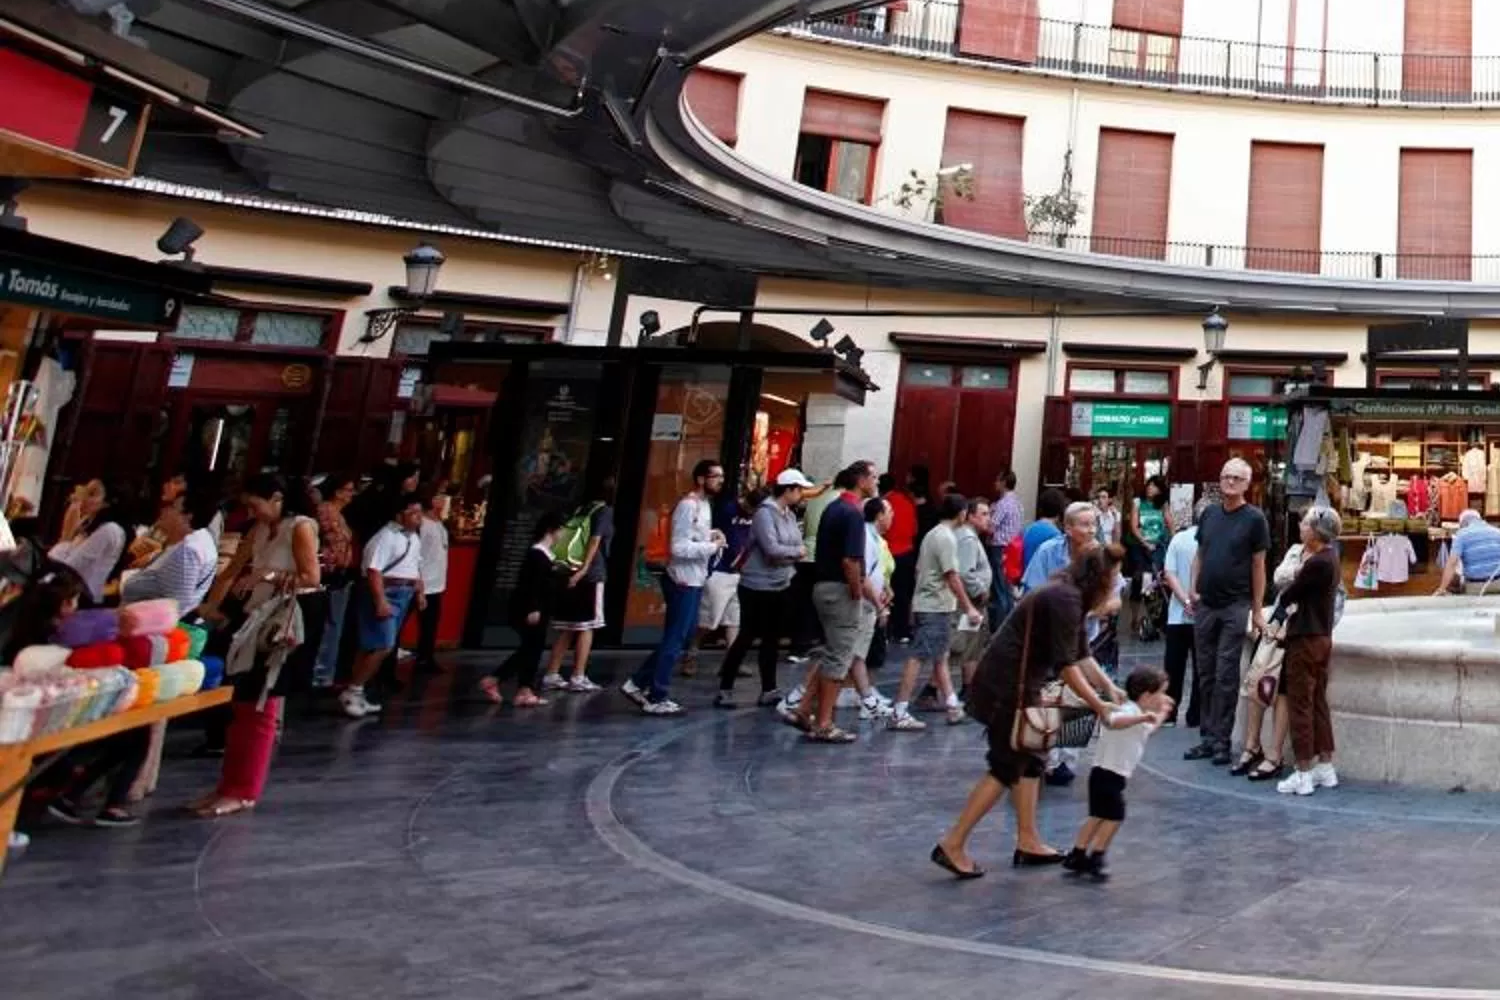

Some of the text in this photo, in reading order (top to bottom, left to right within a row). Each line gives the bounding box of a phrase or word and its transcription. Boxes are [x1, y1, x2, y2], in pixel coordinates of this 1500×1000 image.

[101, 106, 128, 143] 7
[8, 267, 59, 299] Tomás
[165, 298, 175, 318] 9
